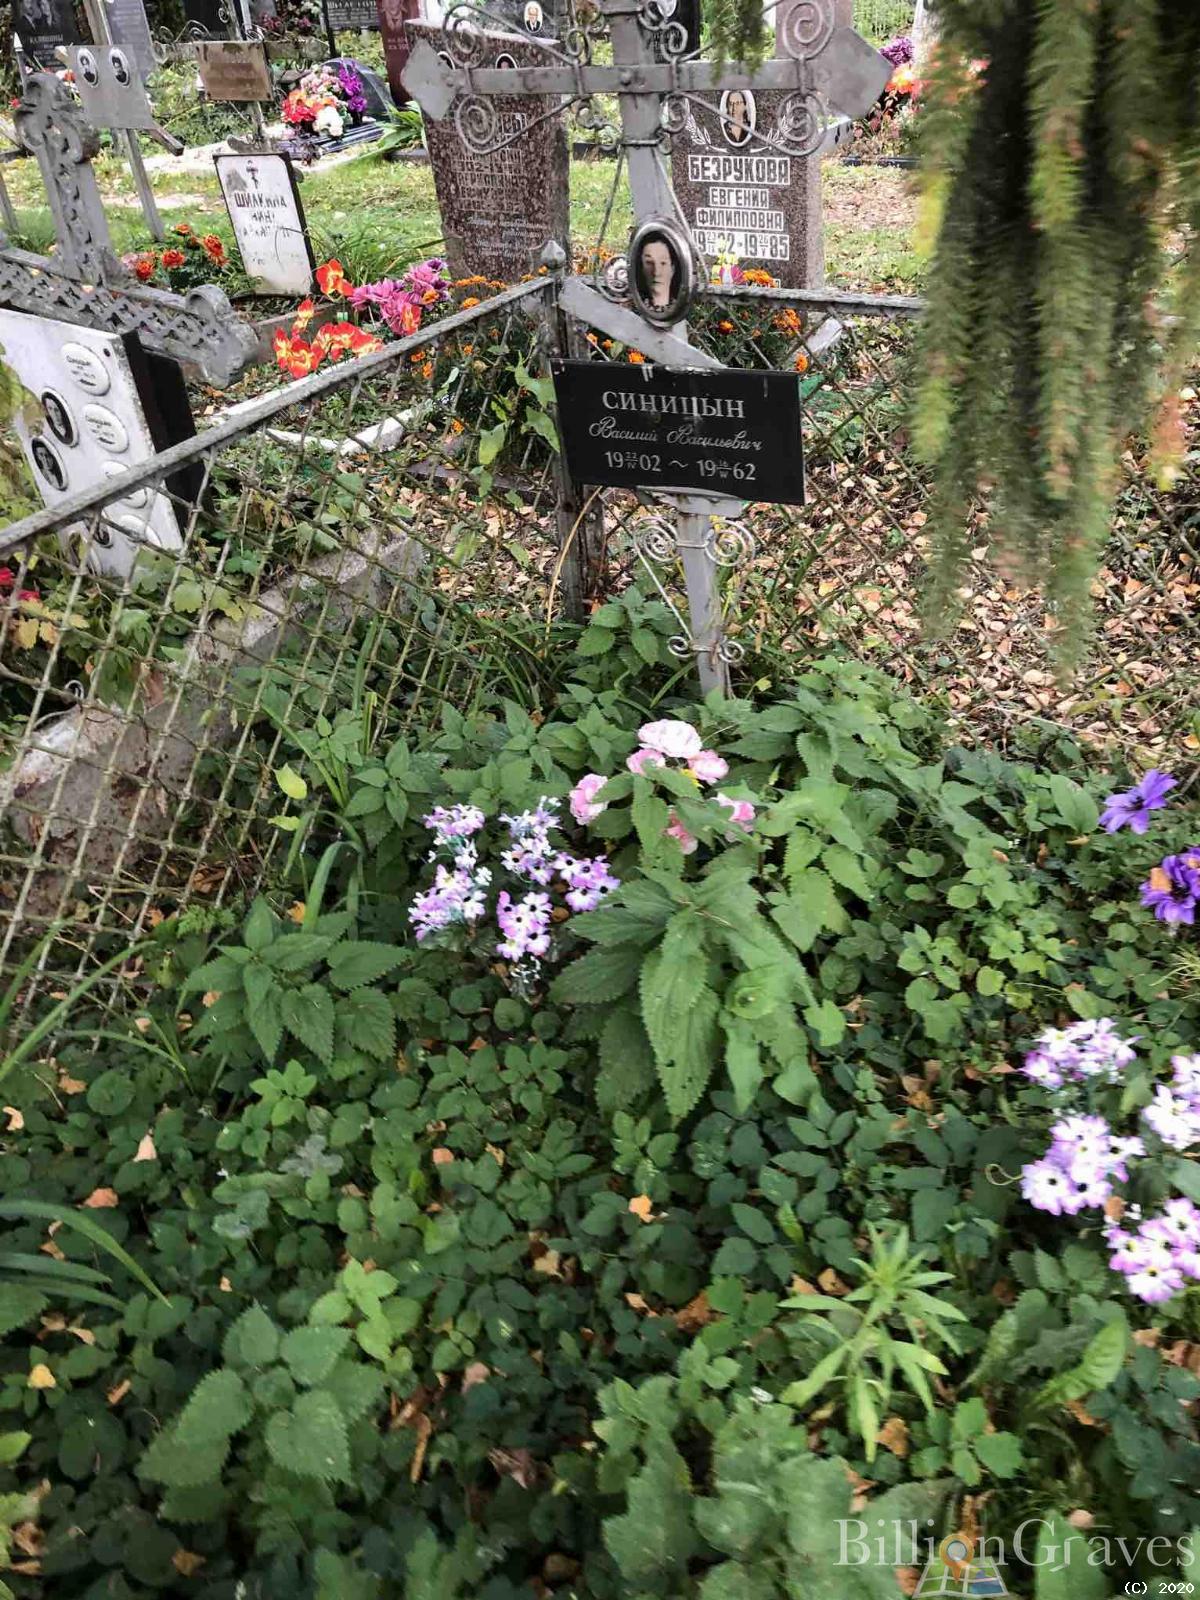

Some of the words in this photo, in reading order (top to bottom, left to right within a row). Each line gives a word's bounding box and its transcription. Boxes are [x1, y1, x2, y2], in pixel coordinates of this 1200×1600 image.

[689, 156, 790, 184] БЕЗРУКОВА
[711, 188, 768, 208] ЕВГЕНИЯ
[697, 209, 784, 230] ФИЛИППОВНА
[601, 390, 746, 420] СИНИЦЫН
[588, 416, 659, 442] Василий
[666, 424, 764, 452] Васильевич
